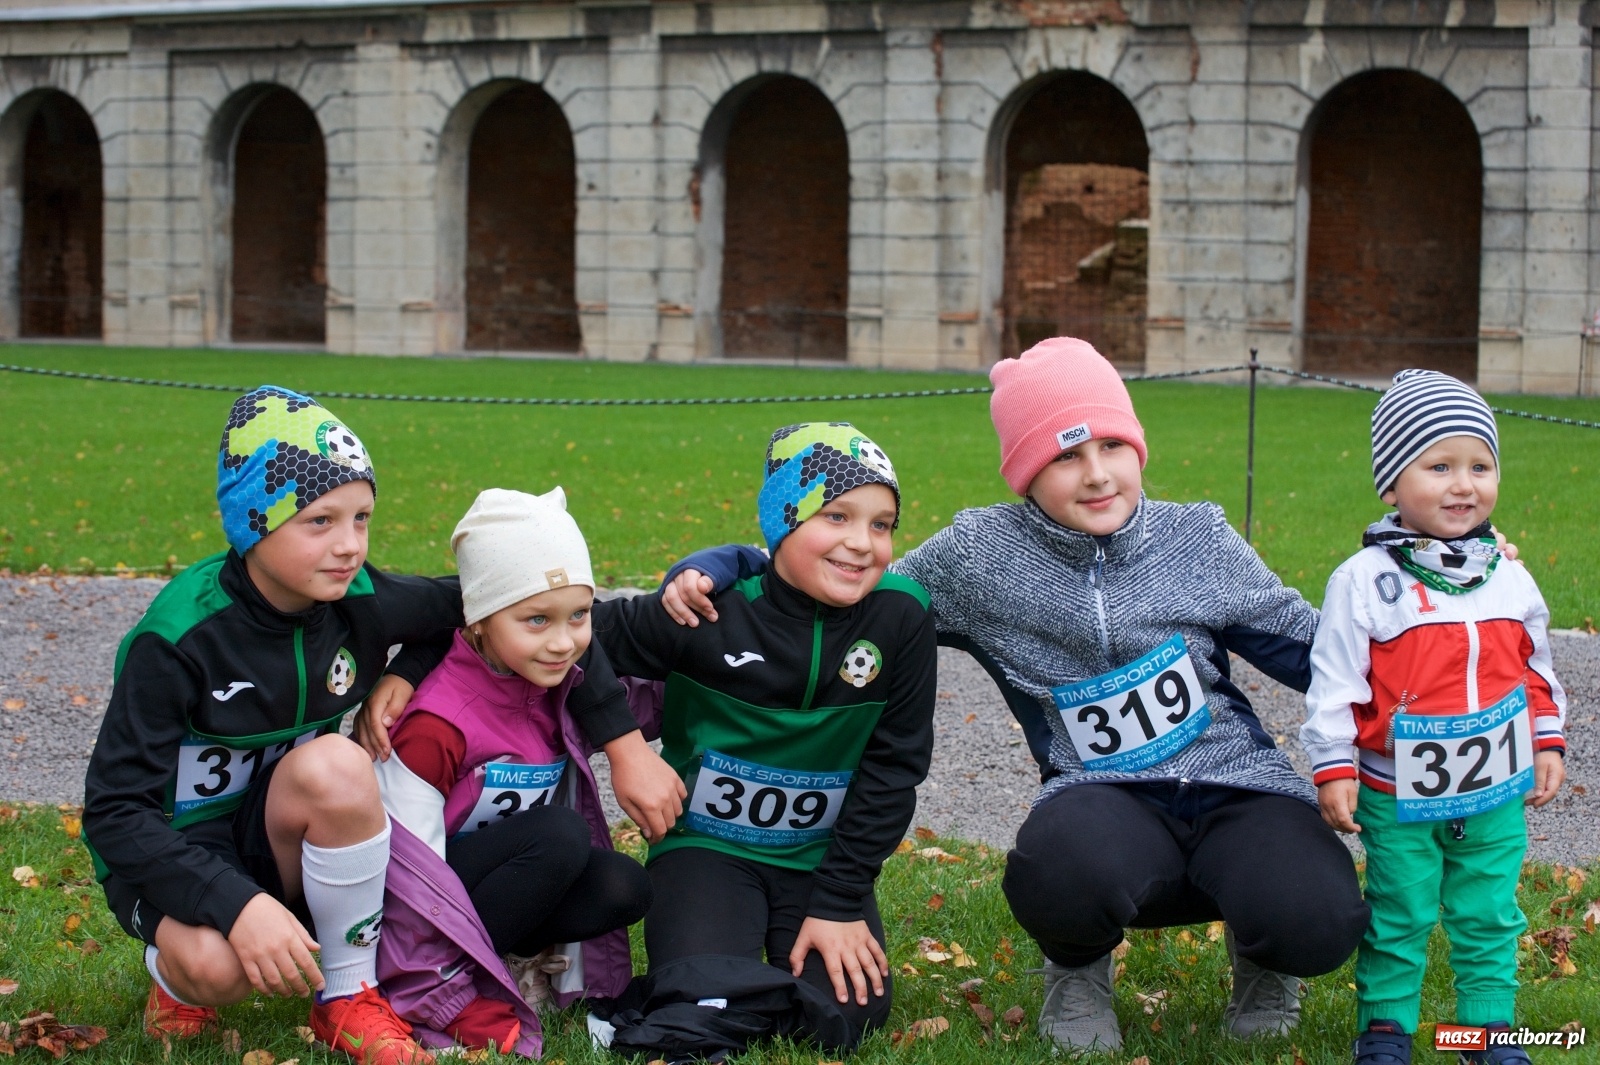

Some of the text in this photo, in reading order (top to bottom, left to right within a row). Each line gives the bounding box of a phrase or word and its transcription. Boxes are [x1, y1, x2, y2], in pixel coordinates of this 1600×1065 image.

[1062, 427, 1086, 442] MSCH
[1058, 644, 1182, 704] TIME-SPORT.PL
[1077, 669, 1191, 755] 319
[1400, 695, 1524, 735] TIME-SPORT.PL
[1090, 757, 1123, 769] NUMER
[1124, 735, 1170, 762] ZWROTNY
[1171, 729, 1184, 741] NA
[1411, 719, 1518, 798] 321
[709, 755, 845, 787] TIME-SPORT.PL
[705, 776, 829, 830] 309
[1404, 802, 1443, 810] NUMER
[1445, 789, 1495, 806] ZWROTNY
[1496, 784, 1508, 794] NA
[693, 815, 729, 830] NUMER
[730, 826, 779, 837] ZWROTNY
